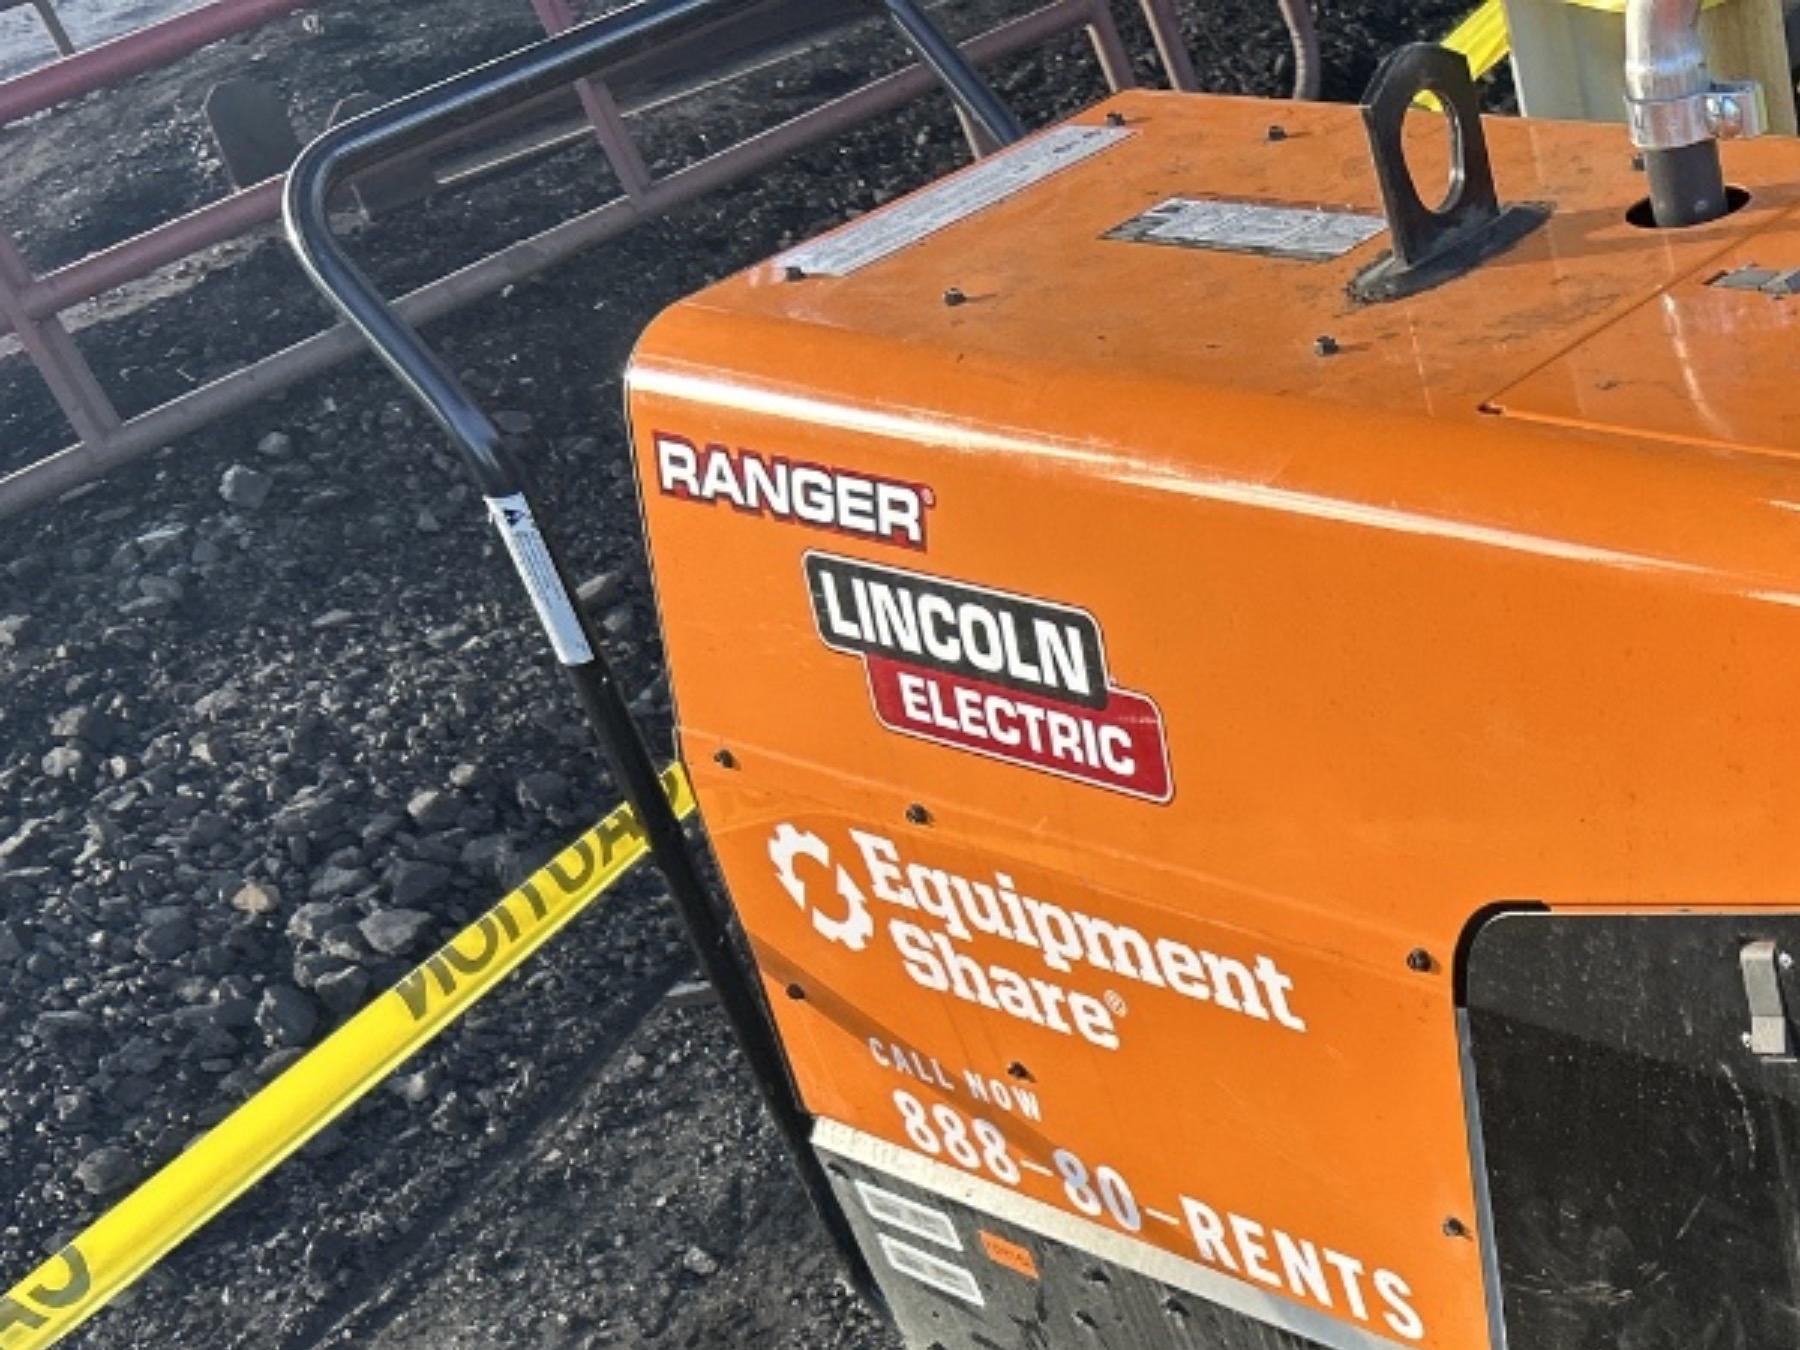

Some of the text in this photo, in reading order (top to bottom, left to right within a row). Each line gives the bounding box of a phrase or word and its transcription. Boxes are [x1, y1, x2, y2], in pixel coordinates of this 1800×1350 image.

[820, 571, 1092, 696] LINCOLN
[899, 673, 1136, 777] ELECTRIC
[848, 828, 1307, 1032] Equipment
[868, 1036, 1043, 1123] CALL NOW
